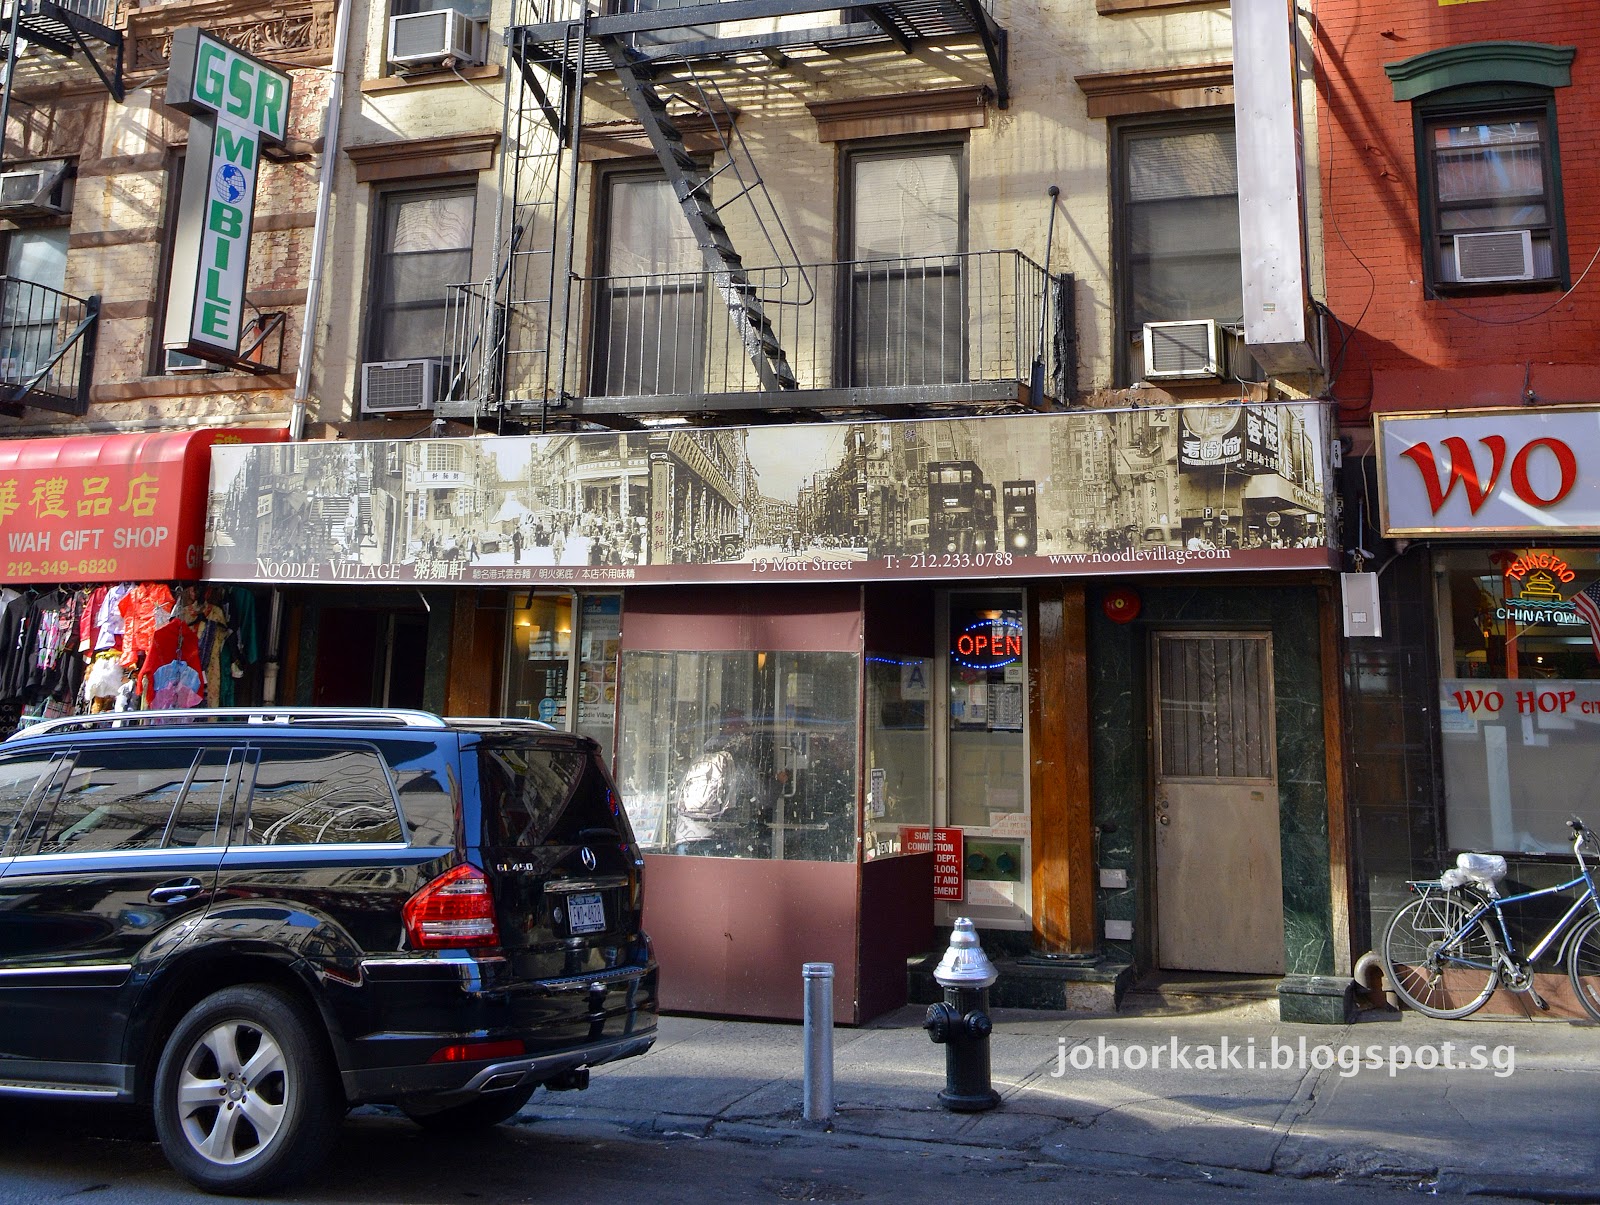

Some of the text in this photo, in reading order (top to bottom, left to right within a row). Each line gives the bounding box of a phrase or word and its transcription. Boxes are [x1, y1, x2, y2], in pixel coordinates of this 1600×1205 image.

[196, 42, 283, 136] GSR
[1399, 435, 1577, 517] WO
[8, 526, 168, 553] WAH GIFT SHOP
[751, 557, 853, 572] 13 Mott Street
[883, 552, 1013, 569] T: 212.233.0788
[1049, 546, 1231, 565] www.noodlevillage.com
[7, 558, 118, 576] 212-349-6820
[254, 557, 320, 579] NOODLE
[328, 558, 400, 579] VILLAGE
[1505, 552, 1575, 583] TSINGTAO
[957, 634, 1021, 656] OPEN
[907, 666, 926, 688] A
[1452, 690, 1504, 714] WO
[1515, 690, 1576, 714] HOP
[512, 863, 533, 871] 450
[936, 854, 958, 863] DEPT.
[943, 876, 959, 885] AND
